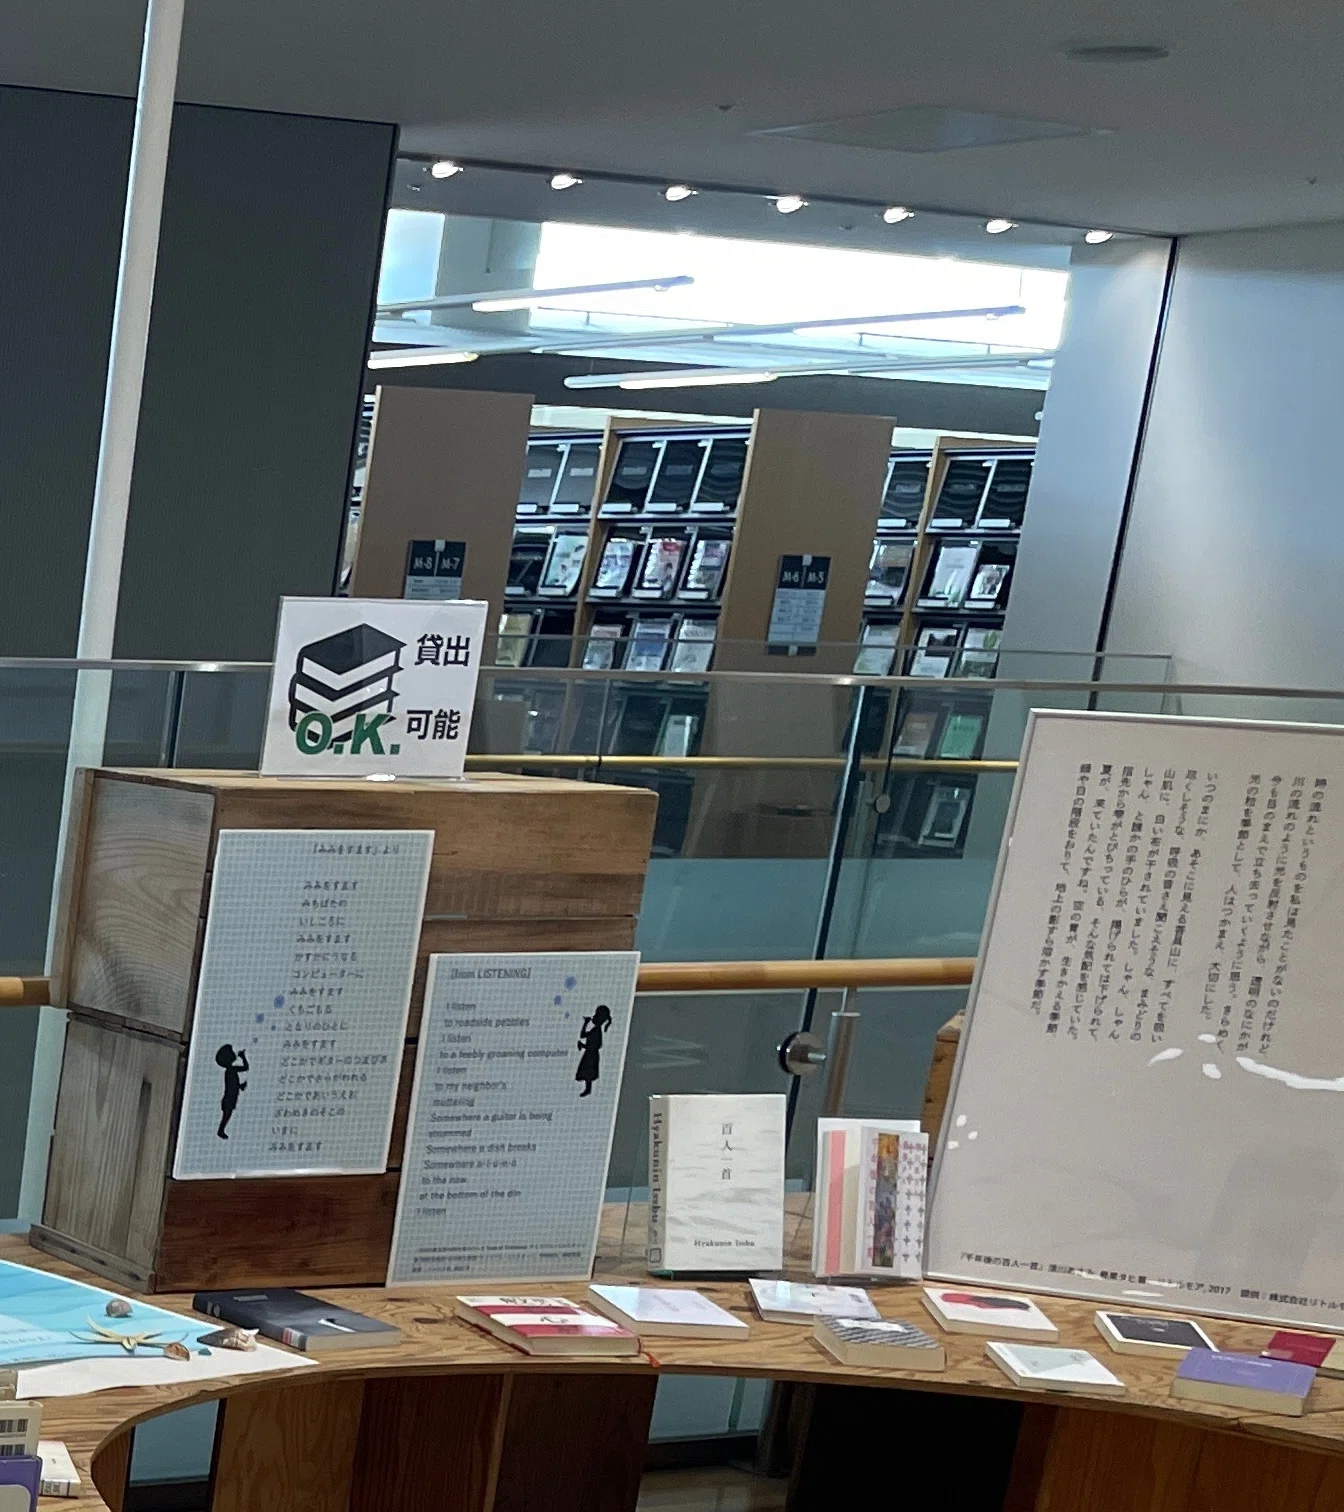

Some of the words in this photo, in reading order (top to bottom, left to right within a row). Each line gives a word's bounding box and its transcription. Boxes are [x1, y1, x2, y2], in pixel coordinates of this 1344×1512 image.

[415, 633, 470, 667] 貸出
[296, 713, 401, 755] O.K.
[406, 709, 461, 740] 可能
[721, 1123, 733, 1180] 百人一首
